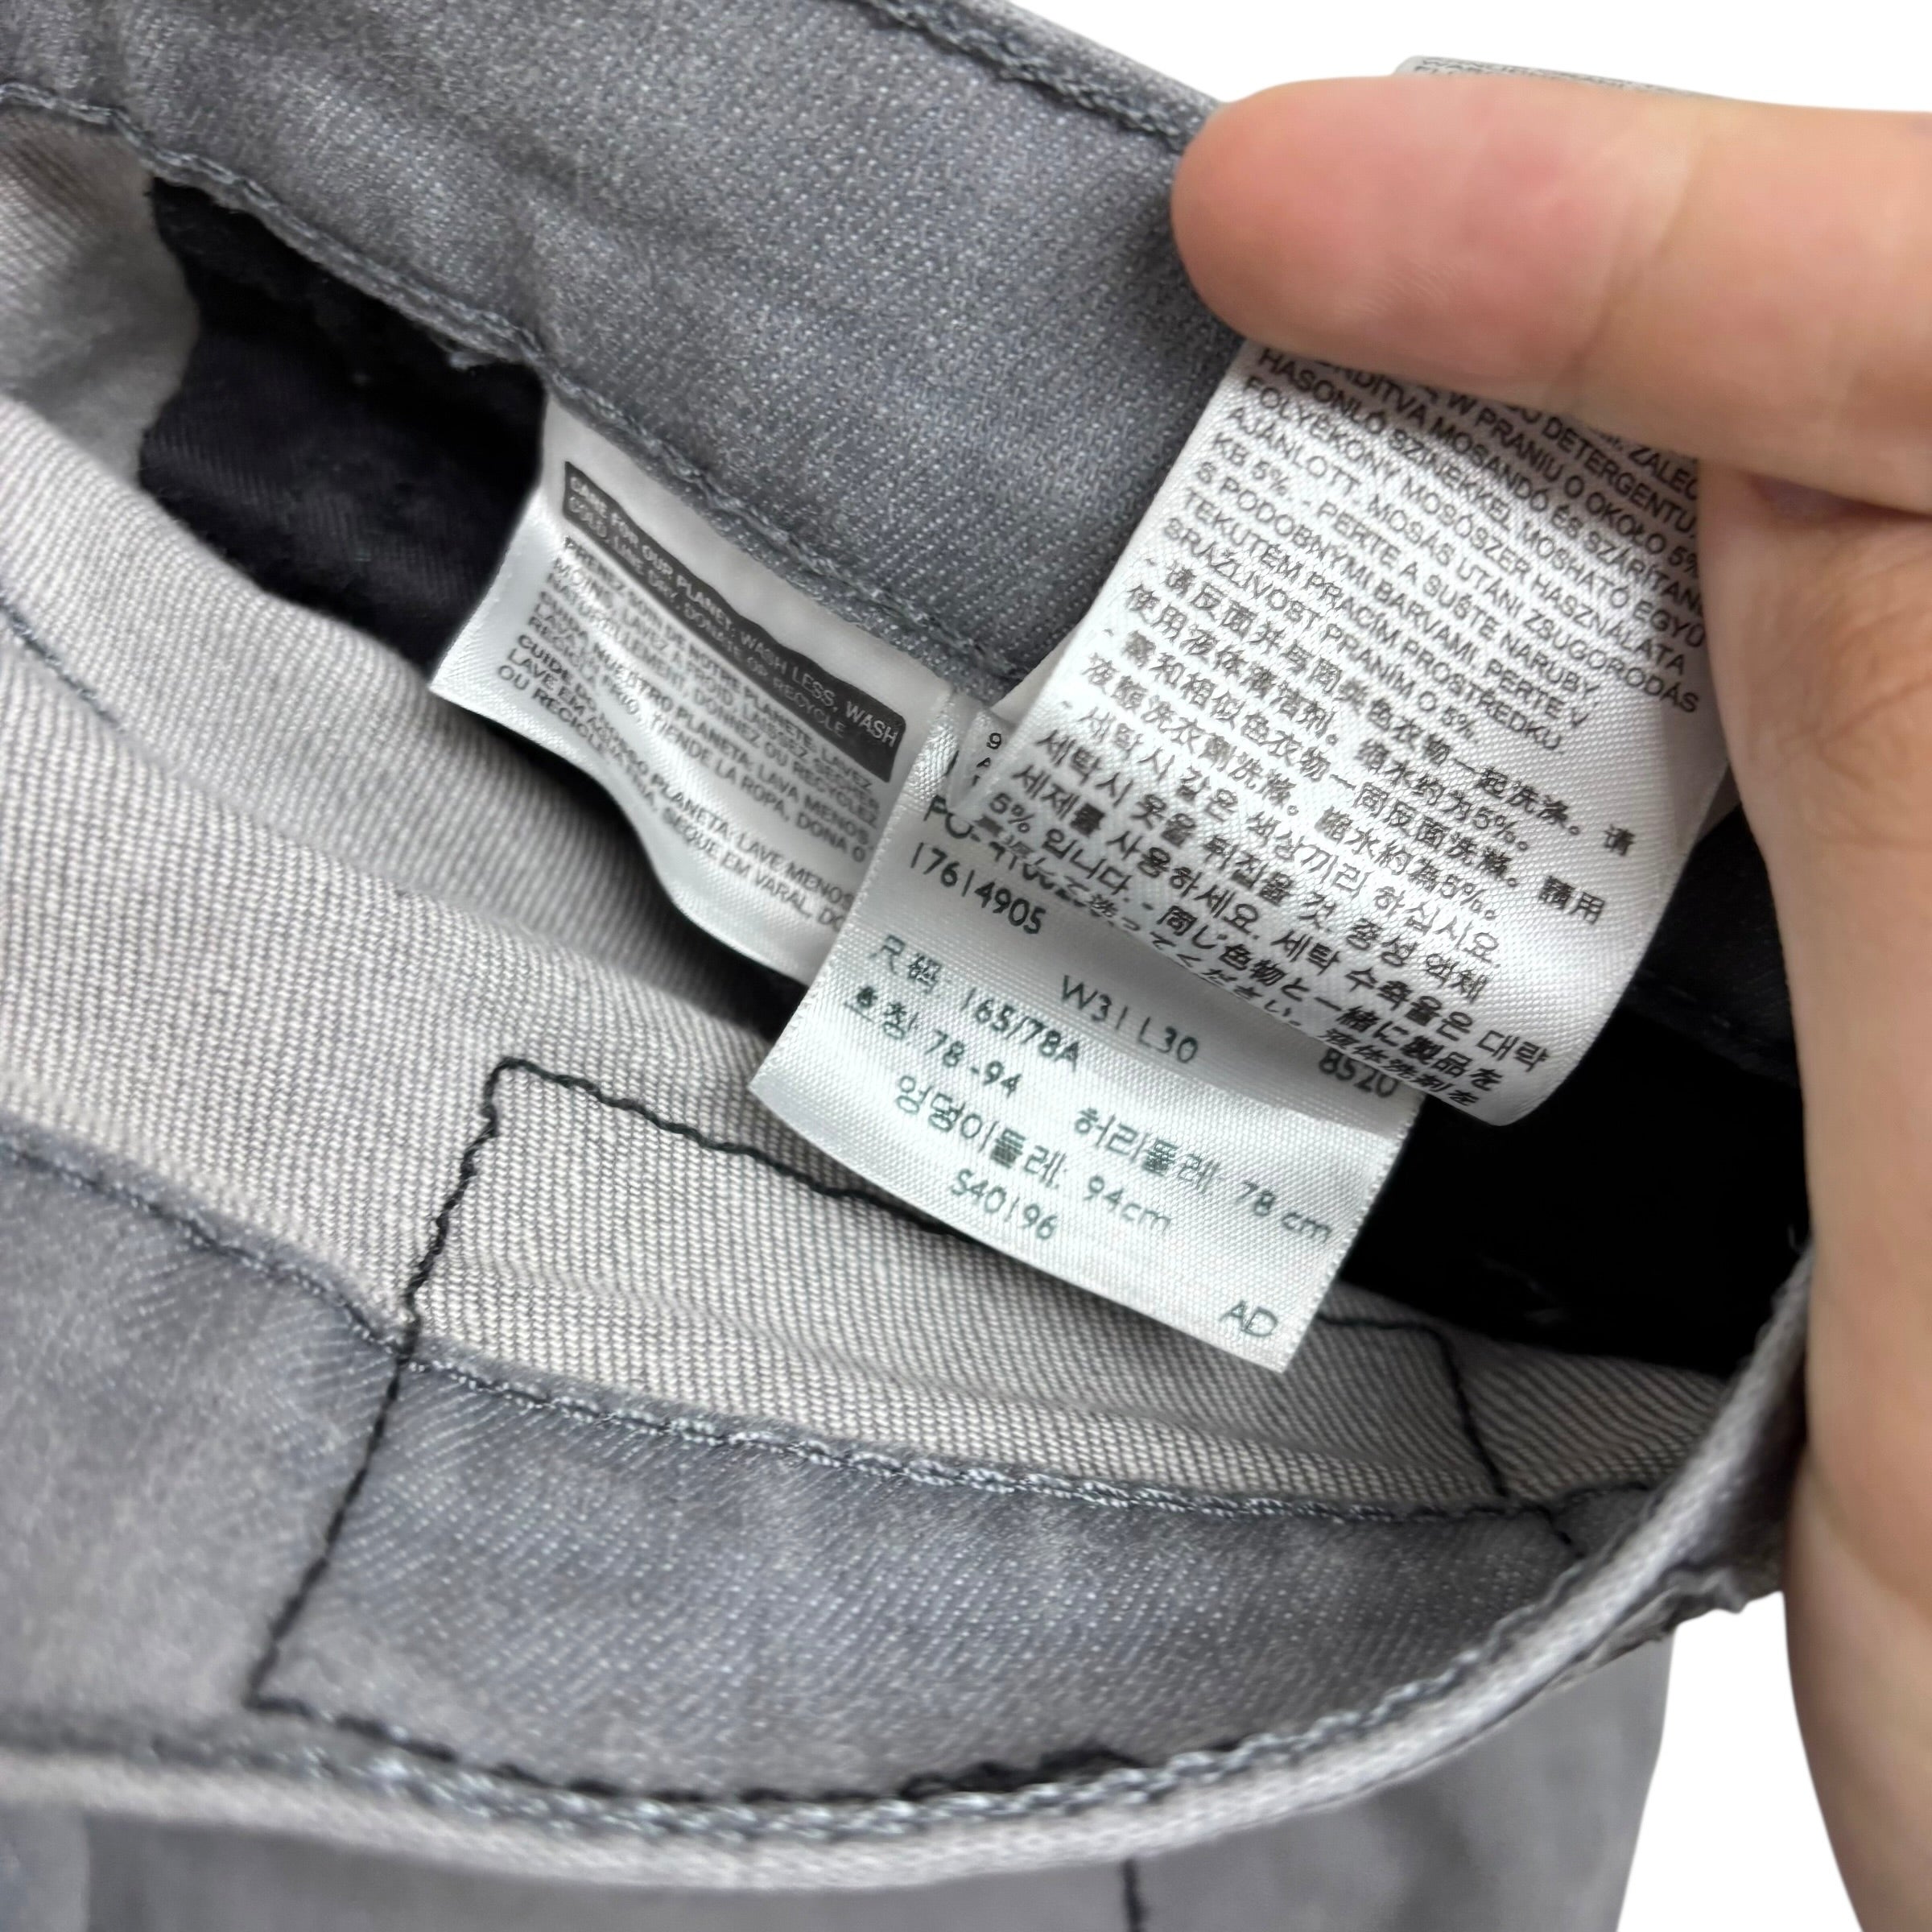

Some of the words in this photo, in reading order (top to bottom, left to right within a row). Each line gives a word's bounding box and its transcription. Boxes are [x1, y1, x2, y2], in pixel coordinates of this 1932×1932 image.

[1210, 432, 1249, 469] KB
[1316, 499, 1402, 568] PERTE
[1398, 559, 1423, 584] A
[1422, 572, 1501, 642] SUŠTE
[1241, 374, 1402, 488] FOLYÉKONY
[1399, 477, 1531, 584] MOSÓSZER
[1530, 573, 1690, 676] HASZNÁLATA
[1257, 346, 1390, 437] HASONLÓ
[1517, 520, 1633, 611] MOSHATÓ
[1430, 416, 1554, 514] MOSANDÓ
[1550, 502, 1583, 539] ÉS
[1474, 407, 1564, 483] PRANIU
[1560, 473, 1587, 501] O
[1583, 490, 1669, 557] OKOŁO
[495, 663, 530, 691] OU
[607, 511, 643, 548] FOR
[638, 543, 676, 577] OUR
[736, 629, 790, 674] WASH
[789, 667, 843, 712] LESS,
[840, 700, 900, 748] WASH
[680, 601, 746, 663] DONATE
[770, 675, 848, 738] RECYCLE
[1302, 570, 1402, 647] PRACÍM
[1321, 621, 1417, 700] PRANÍM
[1415, 688, 1440, 714] O
[1365, 493, 1455, 567] MOSÁS
[1455, 557, 1525, 617] UTÁNI
[1523, 608, 1703, 715] ZSUGORODÁS
[506, 648, 559, 693] LAVE
[556, 686, 587, 716] EM
[720, 851, 759, 884] EM
[515, 632, 574, 687] CUIDE
[737, 830, 785, 871] LAVE
[1483, 658, 1566, 719] PERTE
[1565, 706, 1589, 730] V
[649, 712, 716, 769] TIENDE
[712, 759, 741, 786] LA
[738, 775, 794, 822] ROPA,
[794, 811, 848, 854] DONA
[754, 763, 800, 801] LAVA
[989, 791, 1036, 836] 5%
[1039, 827, 1137, 901] 입니다.
[1030, 726, 1133, 806] 세탁시
[1130, 791, 1197, 847] 옷을
[1196, 832, 1298, 907] 뒤집을
[1075, 704, 1176, 782] 세탁시
[1175, 766, 1241, 823] 같은
[1241, 807, 1370, 900] 색상끼리
[909, 841, 1047, 935] 17614905
[1316, 1046, 1400, 1100] 8520
[1009, 760, 1108, 838] 세제를
[1104, 827, 1268, 938] 사용하세요.
[1268, 923, 1342, 979] 세탁
[1475, 1023, 1549, 1076] 대략
[960, 986, 1085, 1071] 165/78A
[1055, 975, 1129, 1030] W31
[1137, 1017, 1203, 1066] L30
[950, 1167, 1061, 1241] S40196
[1219, 1294, 1281, 1342] AD
[1233, 1179, 1278, 1220] 78
[1278, 1207, 1333, 1247] cm
